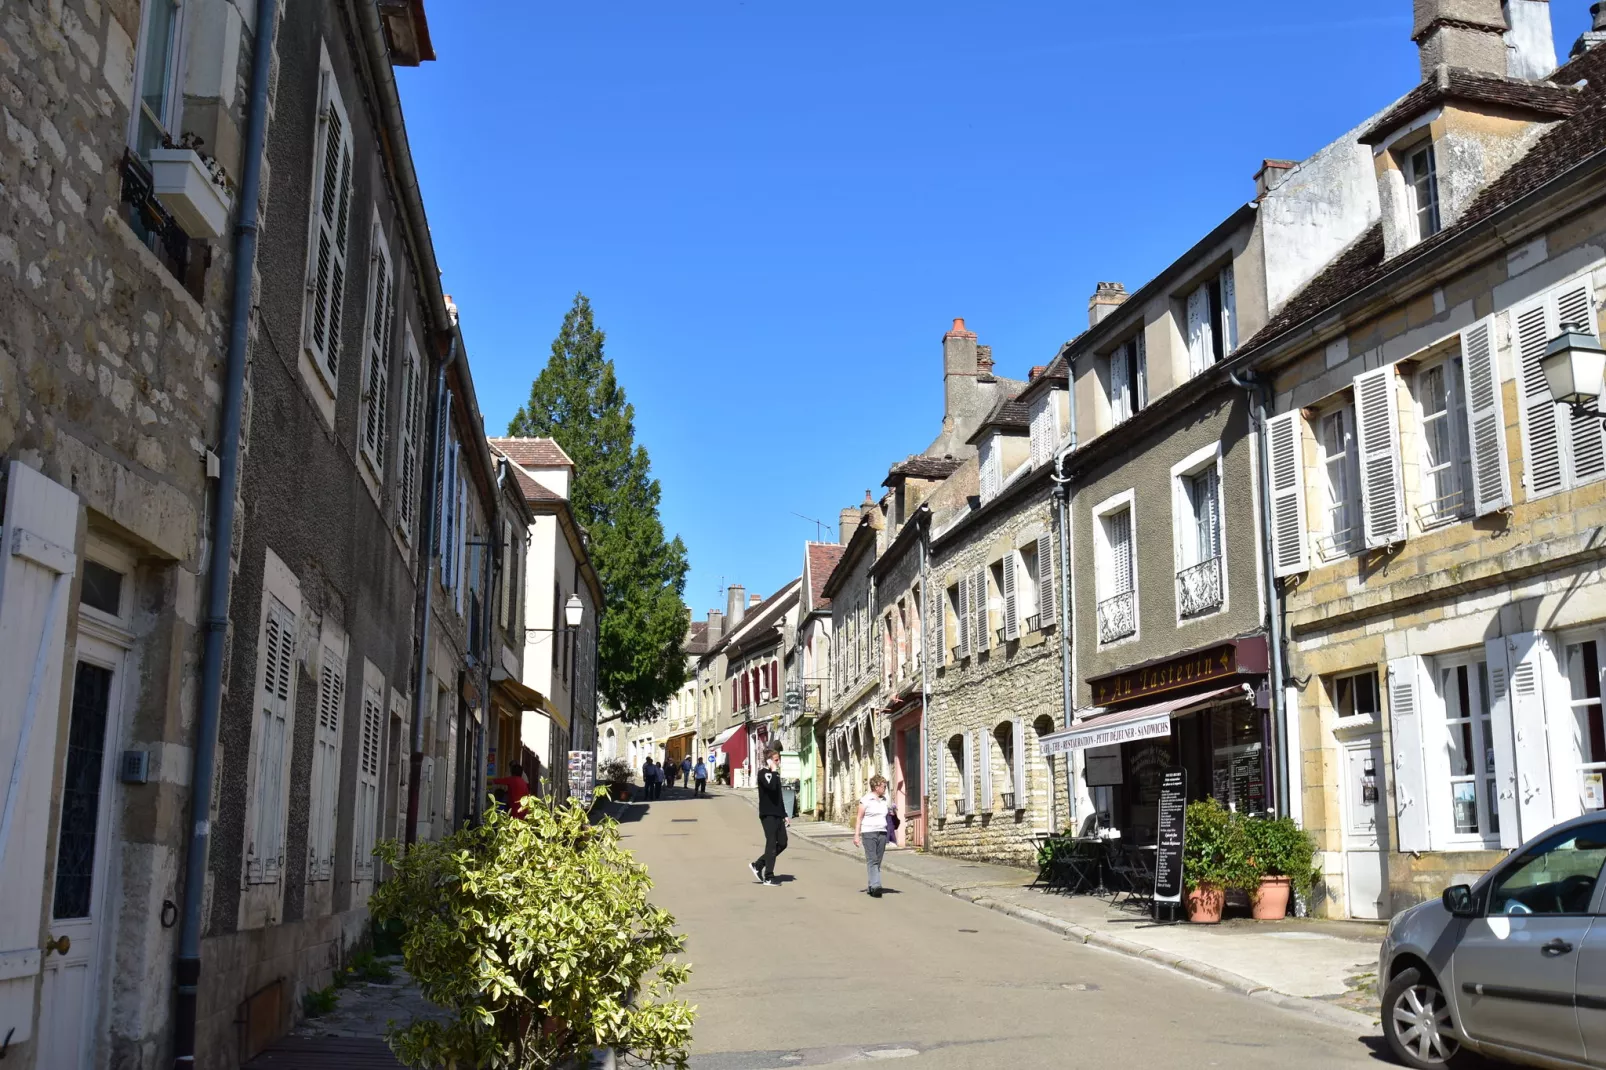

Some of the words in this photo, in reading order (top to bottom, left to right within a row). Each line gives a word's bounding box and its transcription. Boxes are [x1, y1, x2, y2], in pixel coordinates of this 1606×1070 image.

[1112, 676, 1132, 701] Au
[1140, 657, 1213, 690] Tastevin
[1063, 736, 1094, 750] RESTAURATION
[1096, 731, 1109, 743] PETIT
[1137, 721, 1169, 736] SANDWICHS
